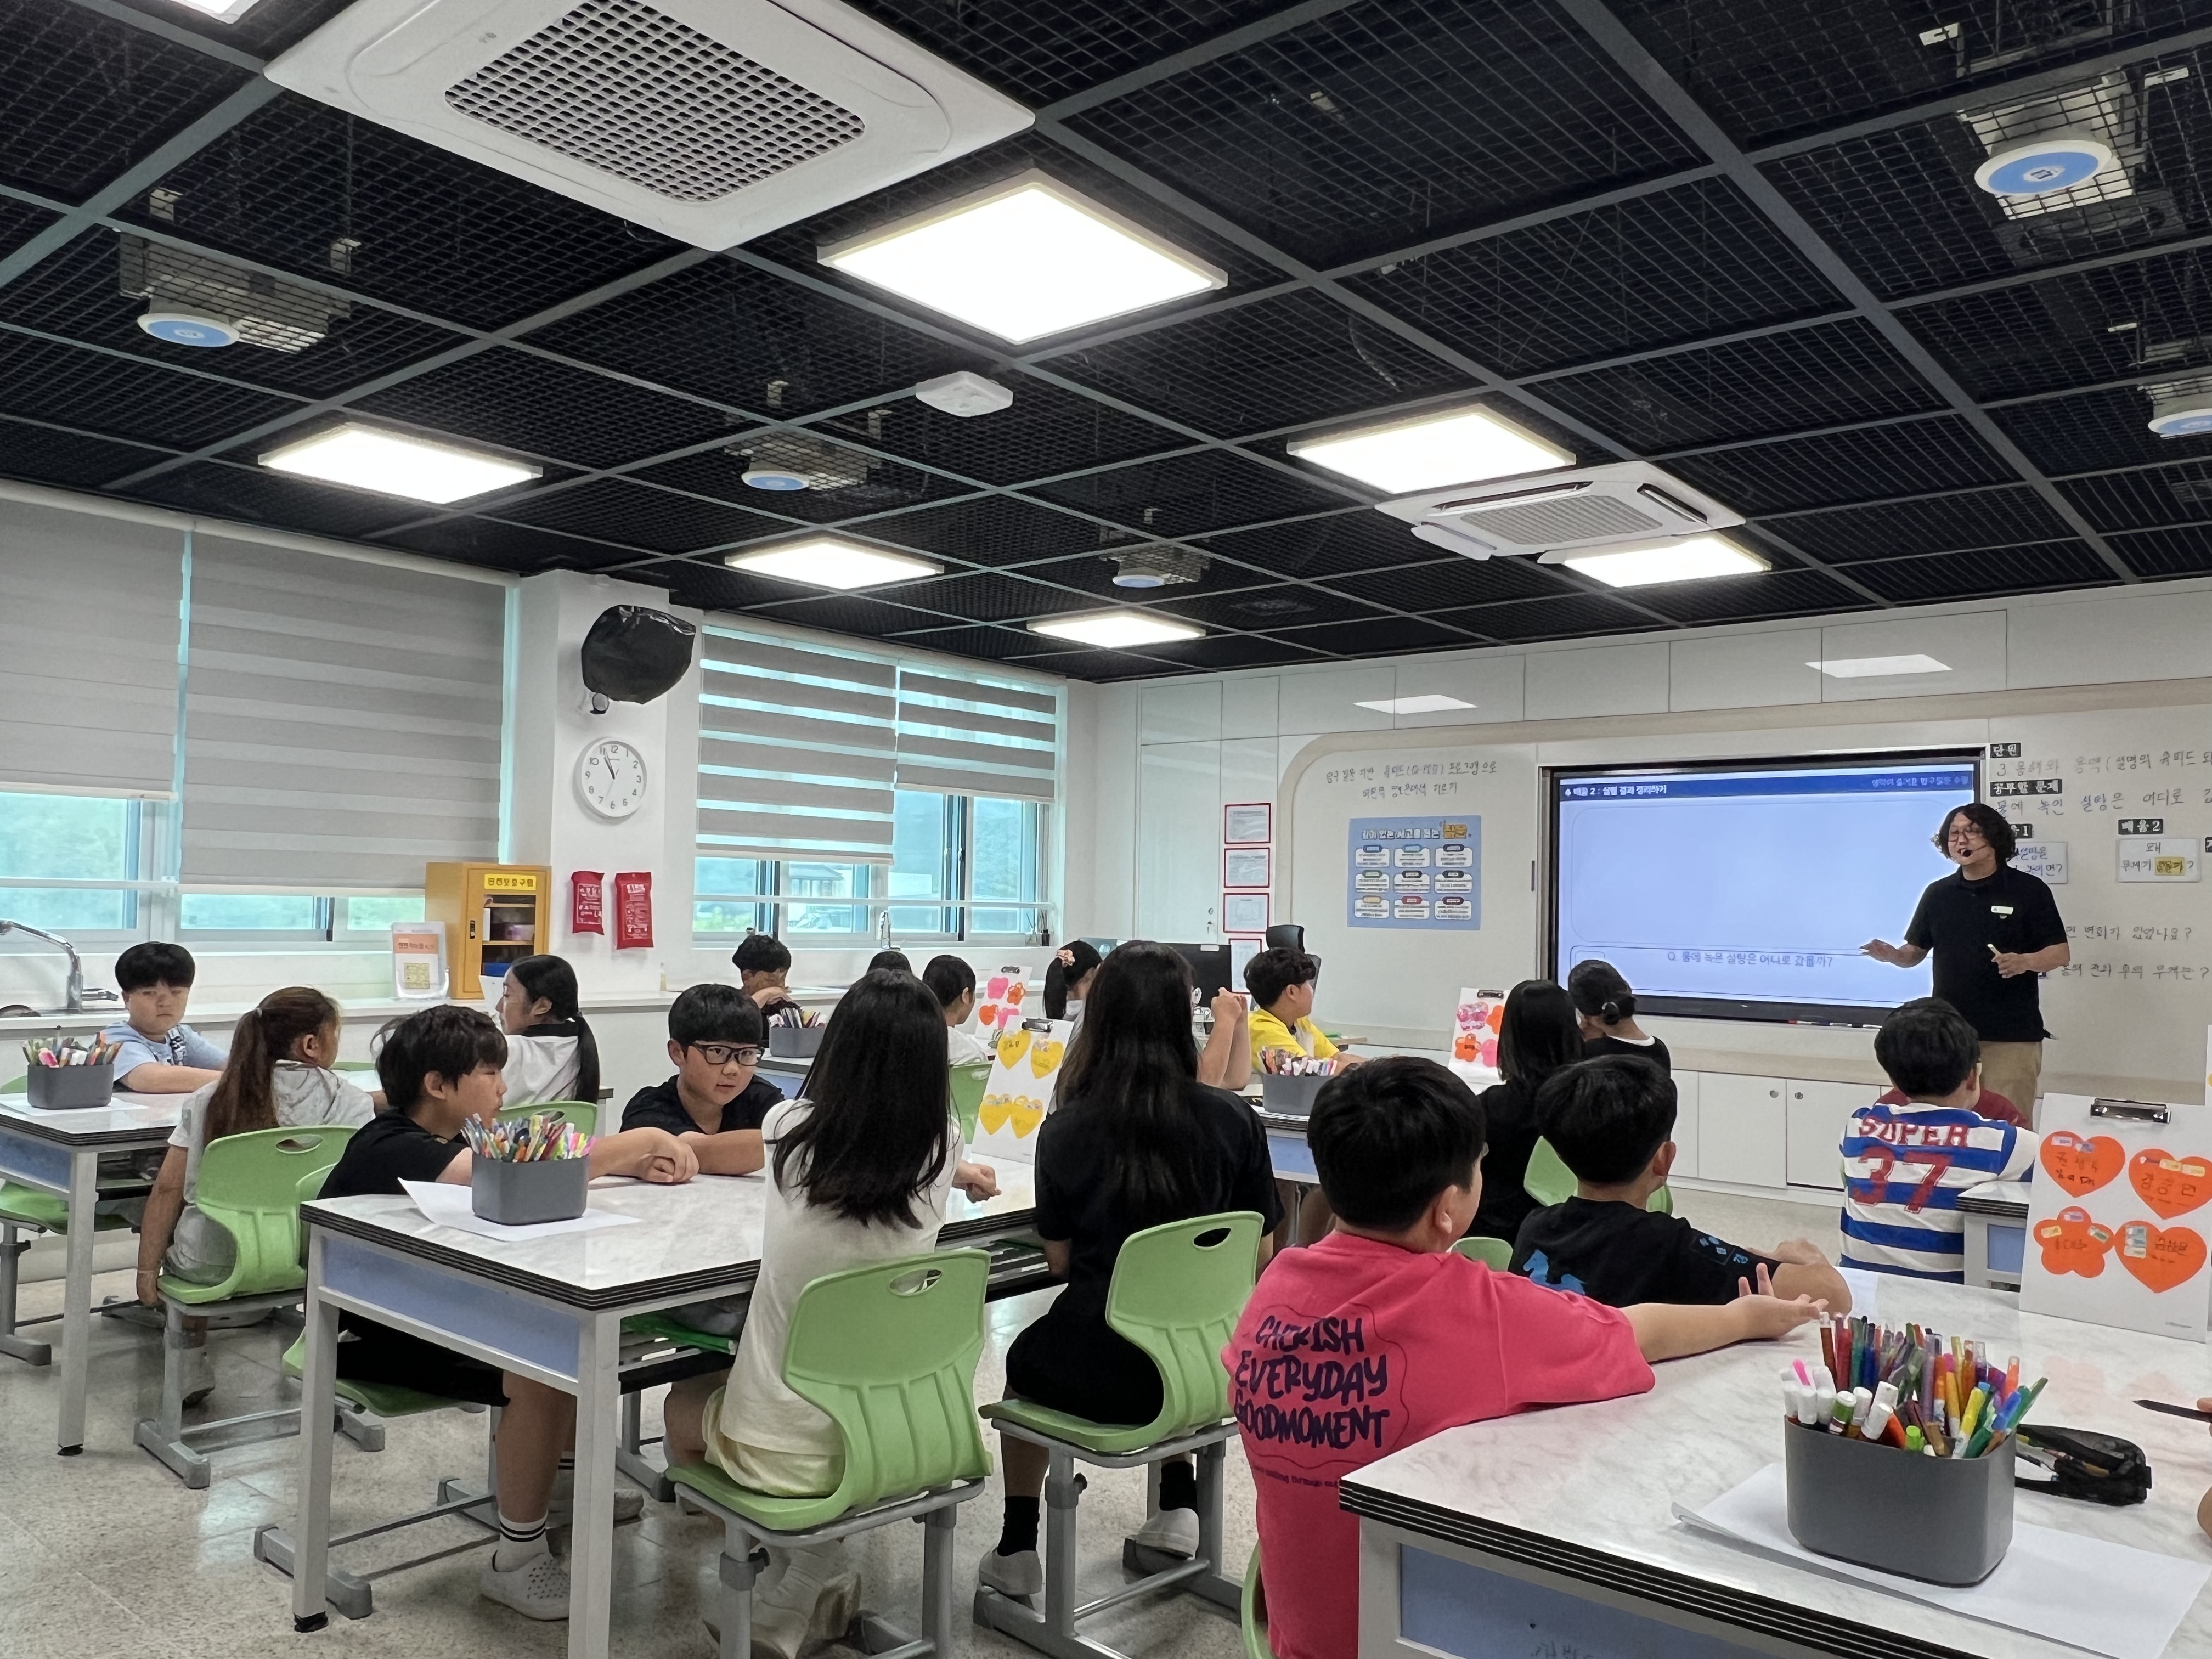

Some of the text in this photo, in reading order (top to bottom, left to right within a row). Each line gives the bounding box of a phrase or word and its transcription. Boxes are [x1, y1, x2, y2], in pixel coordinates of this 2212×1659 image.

[611, 745, 619, 754] 12
[589, 757, 599, 766] 10
[633, 760, 639, 769] 2
[585, 771, 591, 779] 9
[636, 775, 642, 783] 3
[589, 786, 594, 794] 8
[1590, 787, 1596, 795] 2
[598, 795, 604, 804] 7
[2142, 788, 2185, 806] 어디로
[610, 801, 616, 809] 6
[1850, 1146, 1952, 1215] 37
[1235, 1350, 1388, 1406] EVERYDAY
